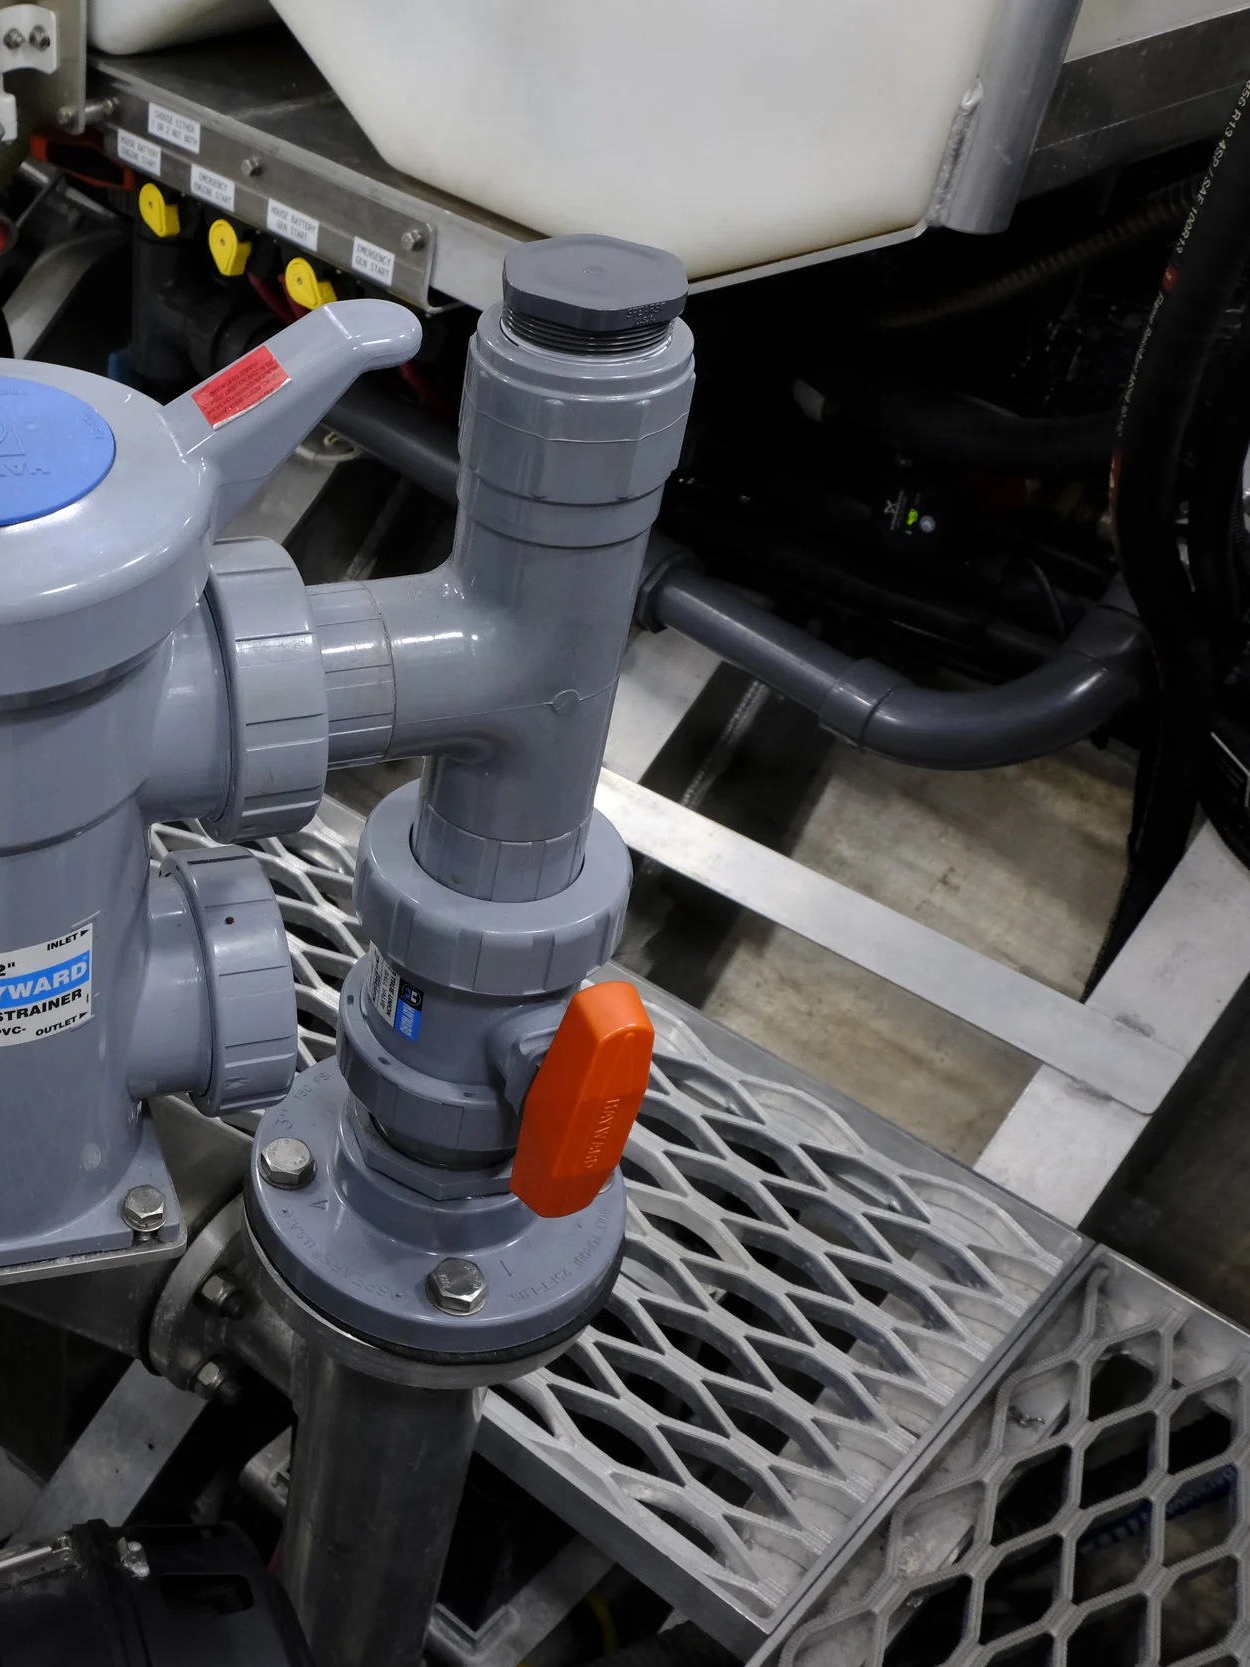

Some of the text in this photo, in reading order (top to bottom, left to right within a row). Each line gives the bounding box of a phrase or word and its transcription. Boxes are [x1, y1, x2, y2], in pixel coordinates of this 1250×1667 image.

[154, 108, 194, 134] CHOOSE EITHER
[157, 121, 163, 131] OR
[165, 125, 169, 134] 2
[171, 127, 181, 139] NOT
[183, 133, 197, 146] BOTH
[1224, 108, 1242, 137] R13
[120, 134, 157, 159] HOUSE BATTERY
[120, 145, 155, 169] ENGINE START
[1213, 138, 1226, 168] 4SP
[193, 179, 231, 205] ENGINE START
[198, 170, 227, 193] EMERGENCY
[1197, 177, 1211, 204] SAE
[270, 204, 316, 233] HOUSE BATTERY
[276, 218, 307, 241] GEN START
[1176, 206, 1198, 253] 100R13
[355, 254, 389, 279] GEN START
[356, 242, 390, 267] EMERGENCY
[46, 932, 78, 951] INLET
[35, 1015, 78, 1037] OUTLET
[584, 1098, 620, 1169] HAYWARD
